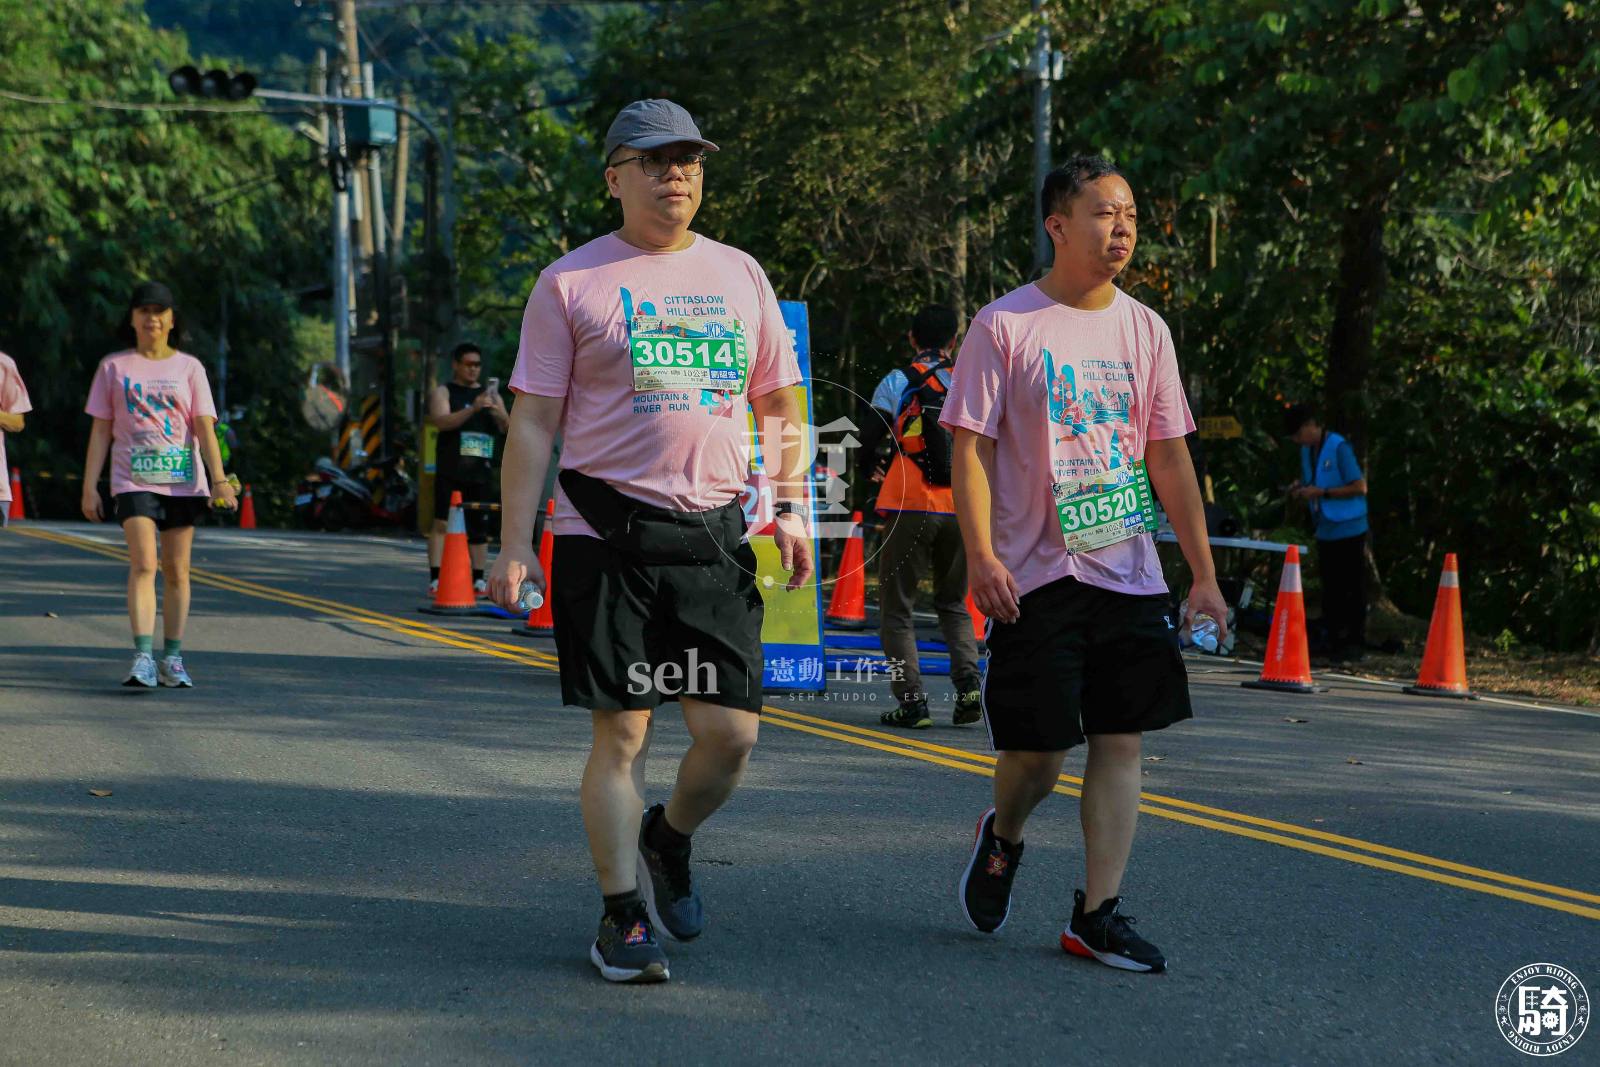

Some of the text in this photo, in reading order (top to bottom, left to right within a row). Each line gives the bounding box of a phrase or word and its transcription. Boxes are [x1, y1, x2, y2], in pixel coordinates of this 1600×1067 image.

[664, 295, 724, 305] CITTASLOW
[666, 306, 727, 316] HILL CLIMB
[635, 340, 734, 367] 30514
[1081, 359, 1133, 370] CITTASLOW
[1083, 372, 1135, 382] HILL CLIMB
[633, 394, 689, 403] MOUNTAIN &
[633, 402, 690, 414] RIVER RUN
[133, 456, 183, 471] 40437
[1083, 467, 1102, 476] RUN
[1061, 488, 1137, 531] 30520
